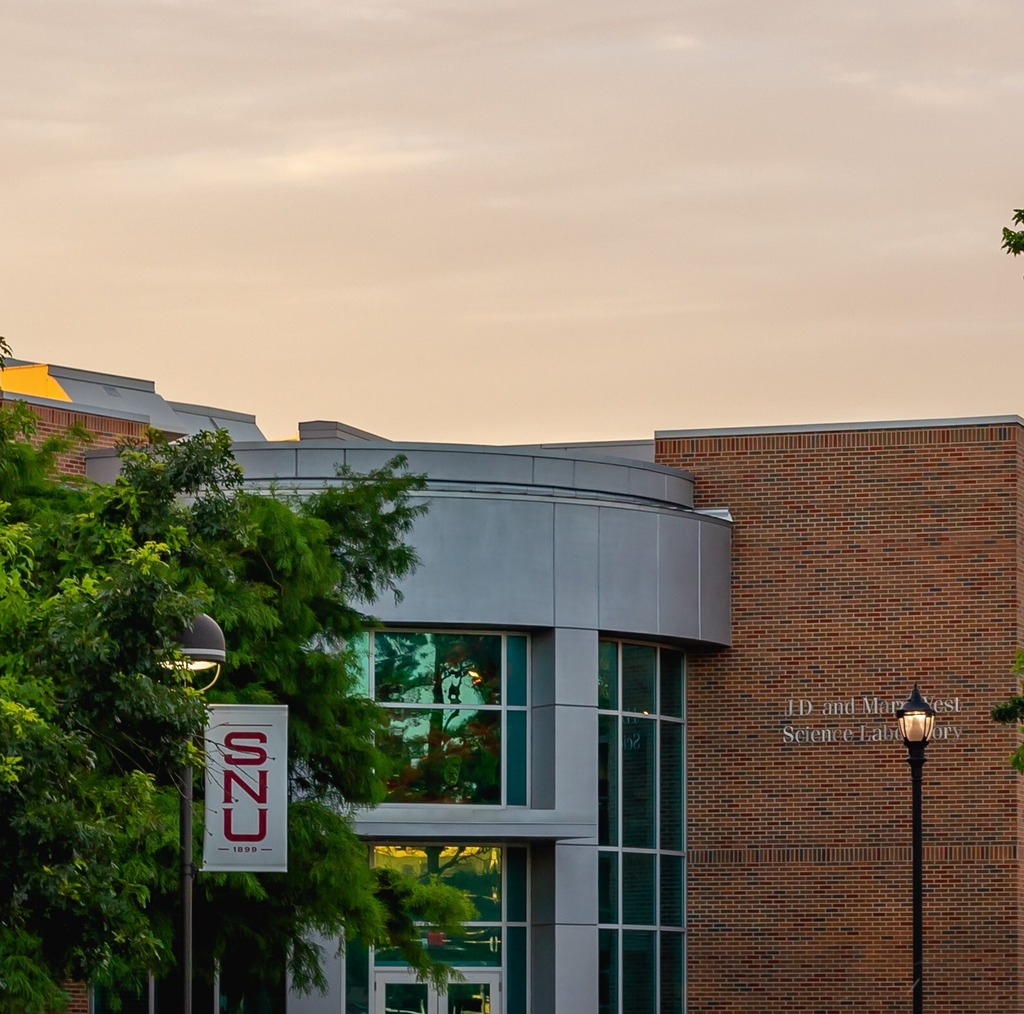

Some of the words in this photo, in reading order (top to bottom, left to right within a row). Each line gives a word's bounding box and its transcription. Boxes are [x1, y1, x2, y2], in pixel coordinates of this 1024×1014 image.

[823, 697, 854, 715] and
[863, 697, 906, 714] Mar
[783, 726, 853, 743] Science
[860, 724, 963, 743] Laboory
[222, 732, 269, 842] SNU
